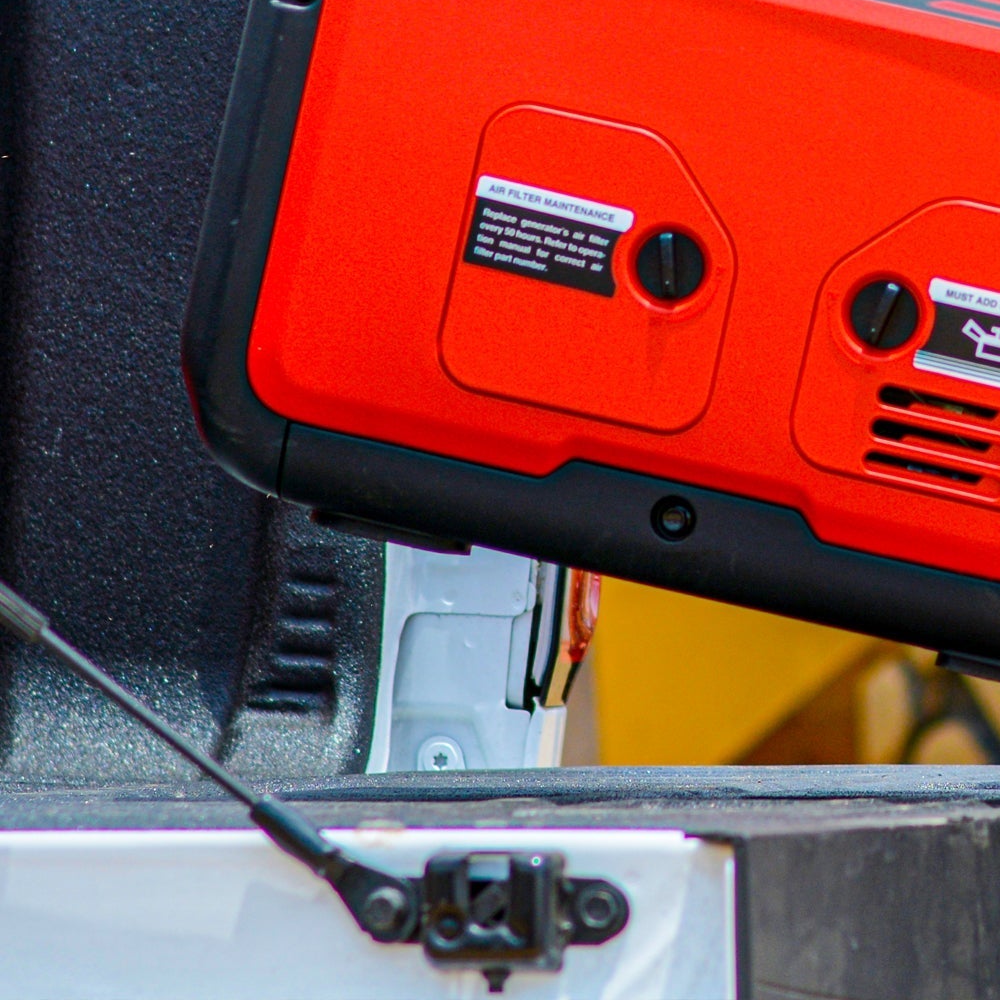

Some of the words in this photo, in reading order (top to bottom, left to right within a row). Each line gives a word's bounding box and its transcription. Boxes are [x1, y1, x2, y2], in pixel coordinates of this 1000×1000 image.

[489, 184, 506, 196] AIR
[508, 188, 542, 205] FILTER
[544, 198, 615, 223] MAINTENANCE
[482, 207, 518, 224] Replace
[520, 217, 570, 237] generator's
[945, 289, 974, 303] MUST
[976, 296, 998, 309] ADD
